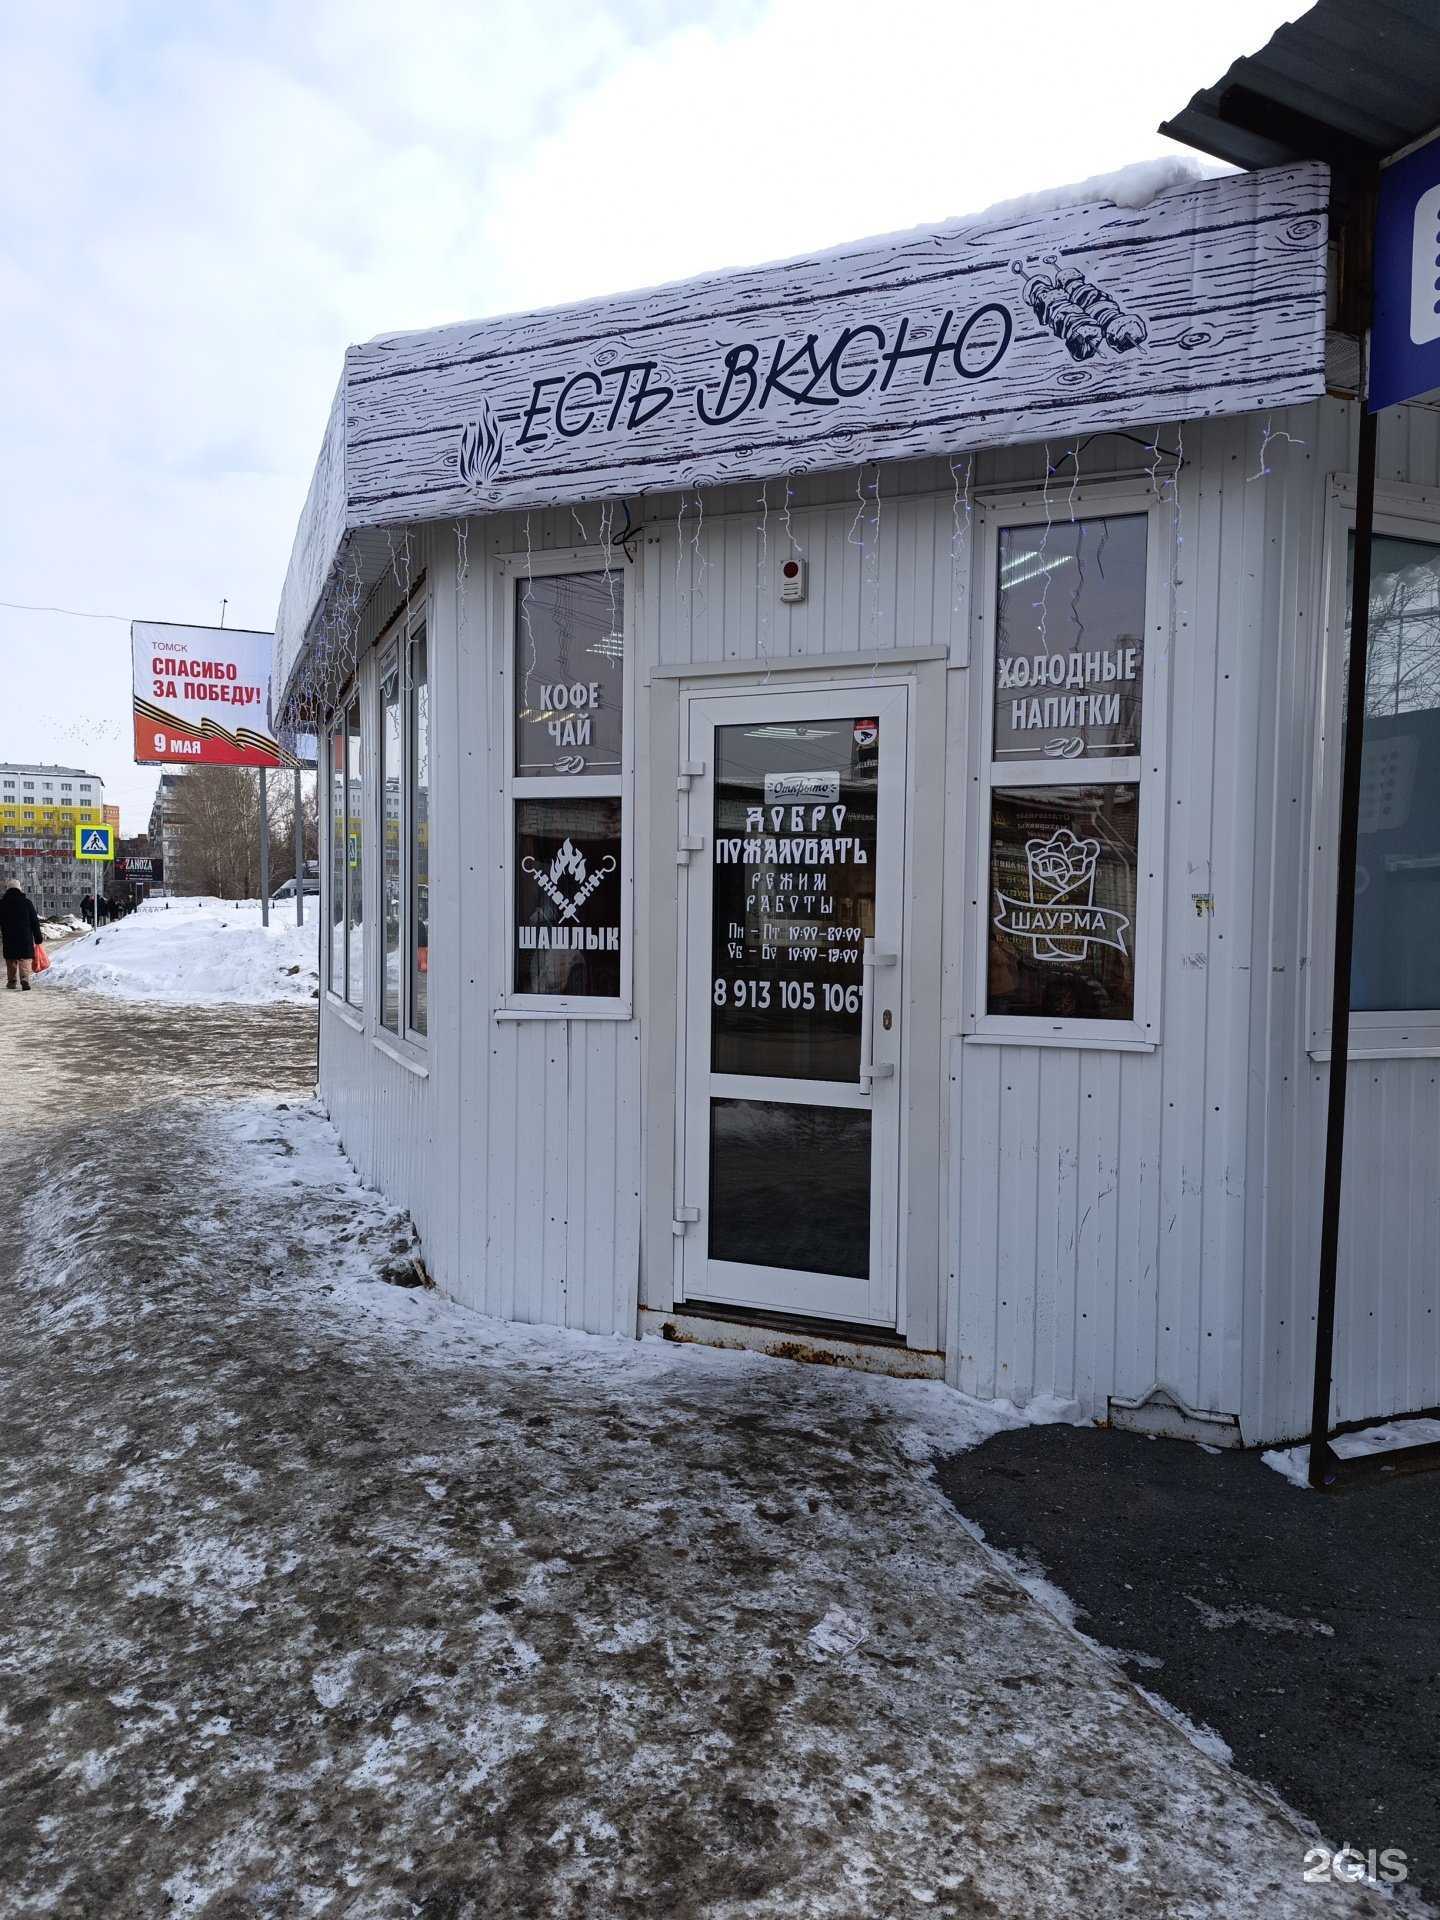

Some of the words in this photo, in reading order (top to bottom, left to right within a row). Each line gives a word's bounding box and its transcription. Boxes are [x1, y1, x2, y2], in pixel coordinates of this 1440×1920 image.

[516, 361, 674, 446] ЕСТЬ
[697, 303, 1012, 425] ВКУСНО
[152, 641, 188, 652] ТОМСК
[152, 657, 237, 680] СПАСИБО
[998, 648, 1136, 689] ХОЛОДНЫЕ
[153, 680, 177, 698] ЗА
[184, 682, 261, 706] ПОБЕДУ!
[540, 682, 600, 710] КОФЕ
[1012, 694, 1120, 729] НАПИТКИ
[548, 713, 591, 746] ЧАЙ
[154, 733, 166, 752] 9
[170, 739, 201, 754] МАЯ
[746, 805, 846, 832] ДОБРО
[716, 838, 867, 864] ПОЖАЛОВАТЬ
[752, 872, 826, 890] РЕЖИМ
[747, 895, 833, 913] РАБОТЫ
[729, 922, 744, 939] Пн
[764, 923, 780, 939] Пт
[1011, 911, 1106, 930] ШАУРМА
[519, 927, 619, 950] ШАШЛЫК
[714, 978, 727, 1006] 8
[734, 979, 771, 1009] 913
[780, 981, 816, 1010] 105
